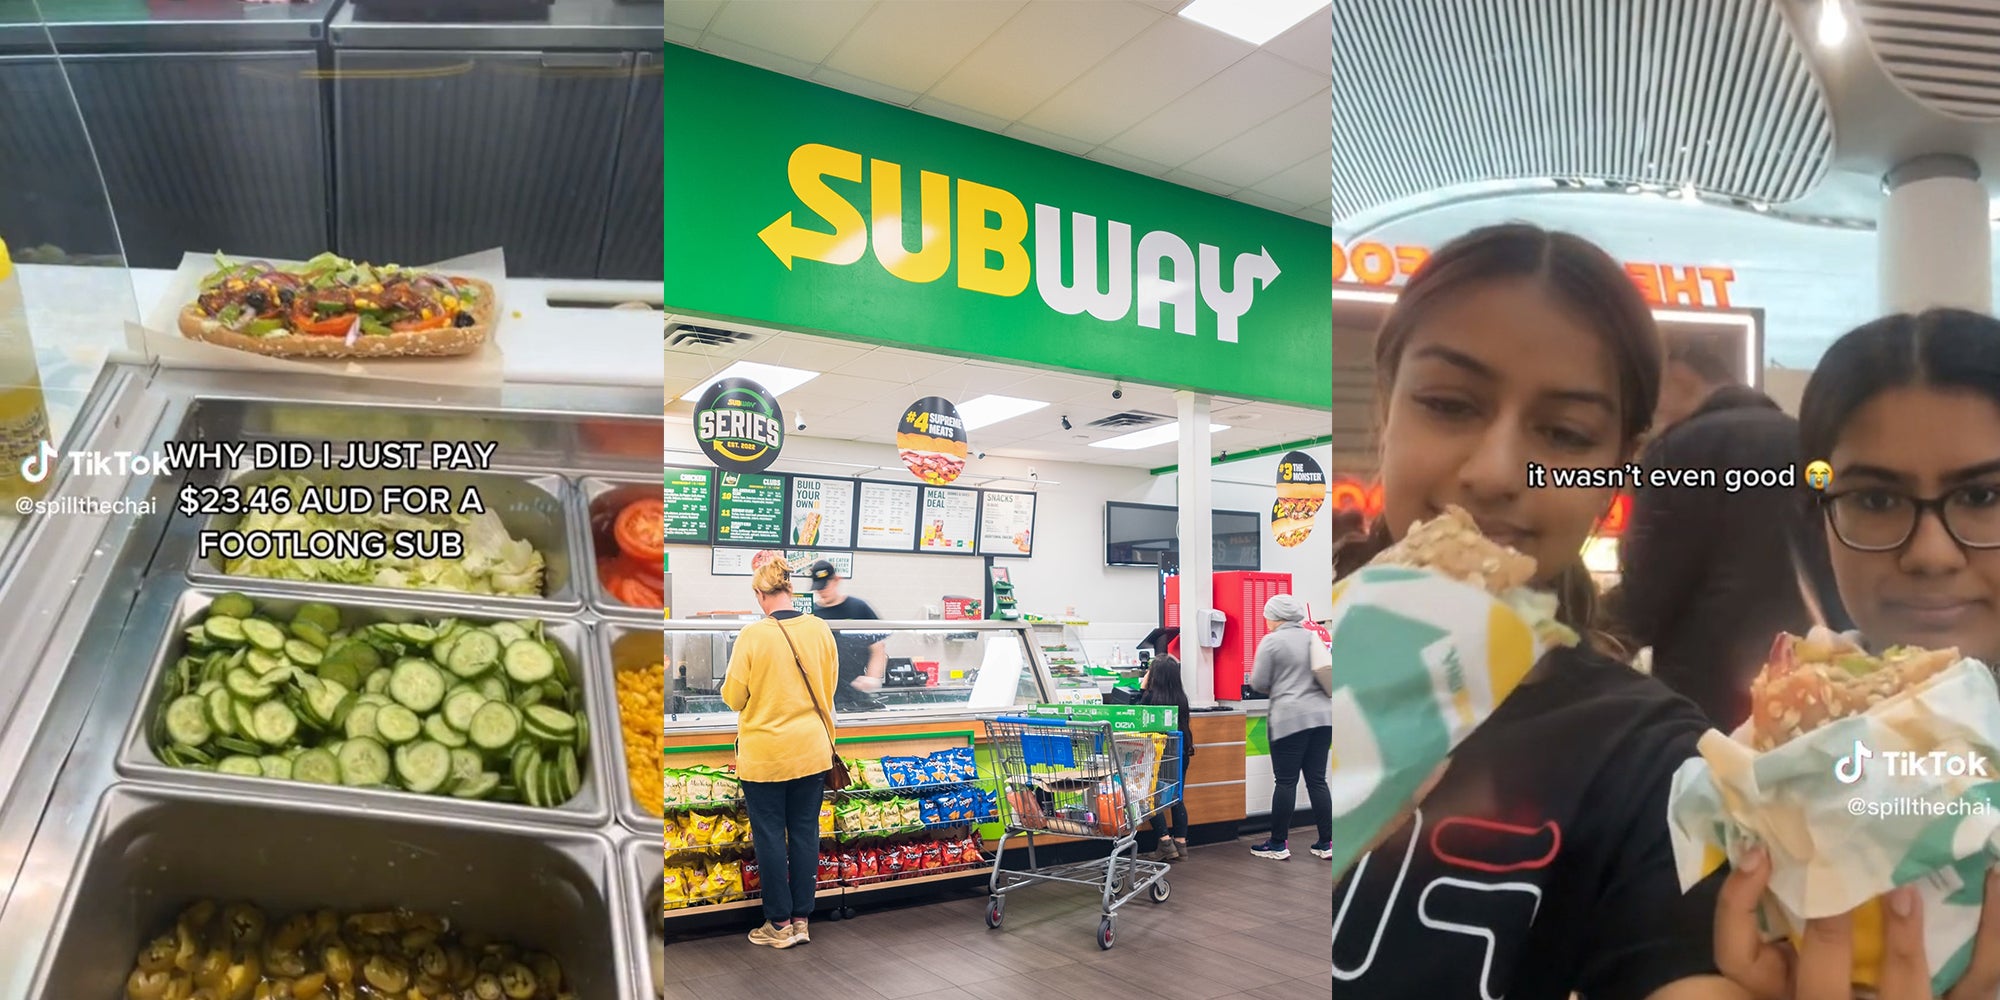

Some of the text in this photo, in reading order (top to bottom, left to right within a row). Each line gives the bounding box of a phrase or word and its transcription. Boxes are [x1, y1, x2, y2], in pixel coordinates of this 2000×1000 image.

[757, 143, 1282, 343] SUBWAY
[727, 399, 756, 408] SUBWAY
[906, 411, 929, 432] #4
[929, 412, 962, 429] SUPREME
[700, 410, 779, 447] SERIES
[929, 424, 954, 438] MEATS
[727, 441, 756, 451] EST. 2022
[1293, 464, 1304, 472] THE
[1293, 472, 1322, 481] MONSTER
[797, 480, 821, 490] BUILD
[796, 490, 820, 500] YOUR
[927, 490, 946, 500] MEAL
[987, 494, 1014, 503] SNACKS
[795, 500, 814, 509] OWN
[926, 499, 945, 509] DEAL
[1115, 721, 1135, 729] VIZIO
